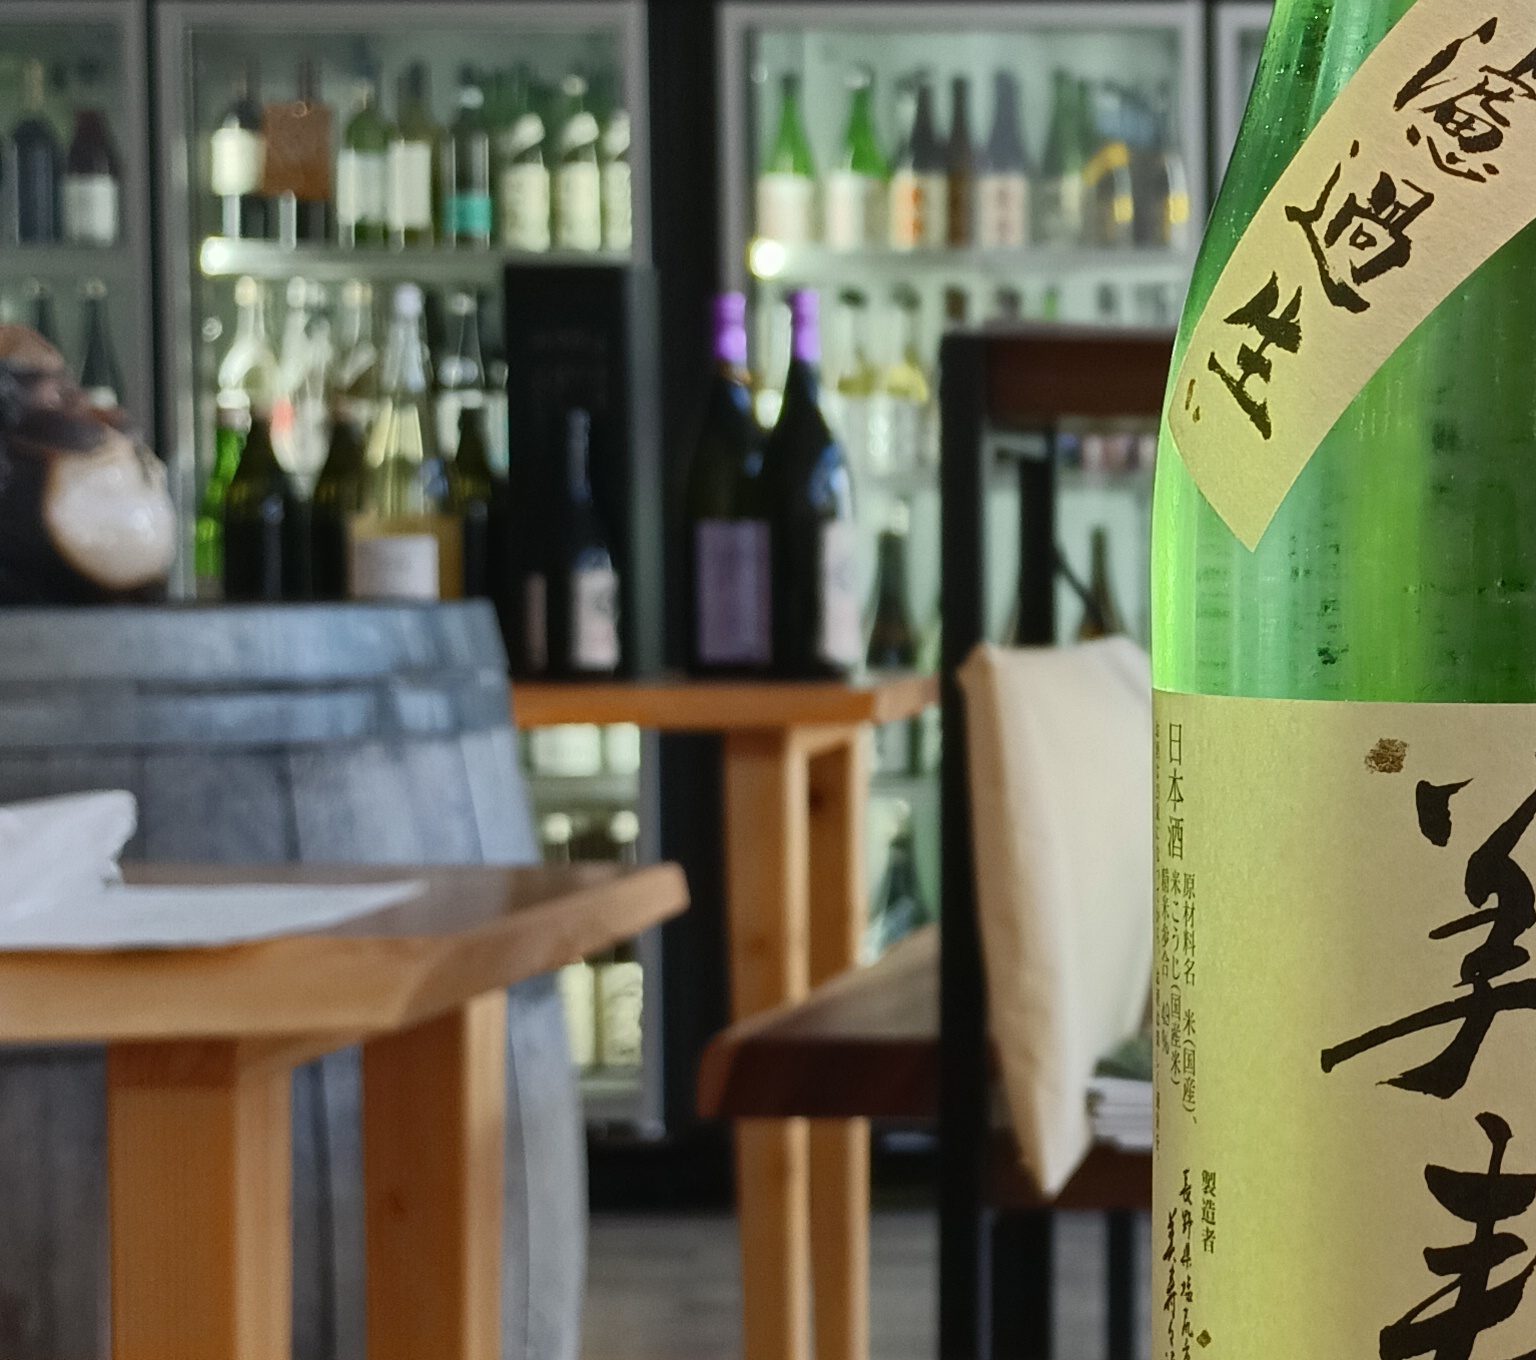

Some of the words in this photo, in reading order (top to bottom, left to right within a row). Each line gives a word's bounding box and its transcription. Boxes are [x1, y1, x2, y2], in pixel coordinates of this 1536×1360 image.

[1166, 723, 1184, 861] 日本酒
[1182, 873, 1197, 986] 原材料名
[1201, 1170, 1216, 1254] 製造者
